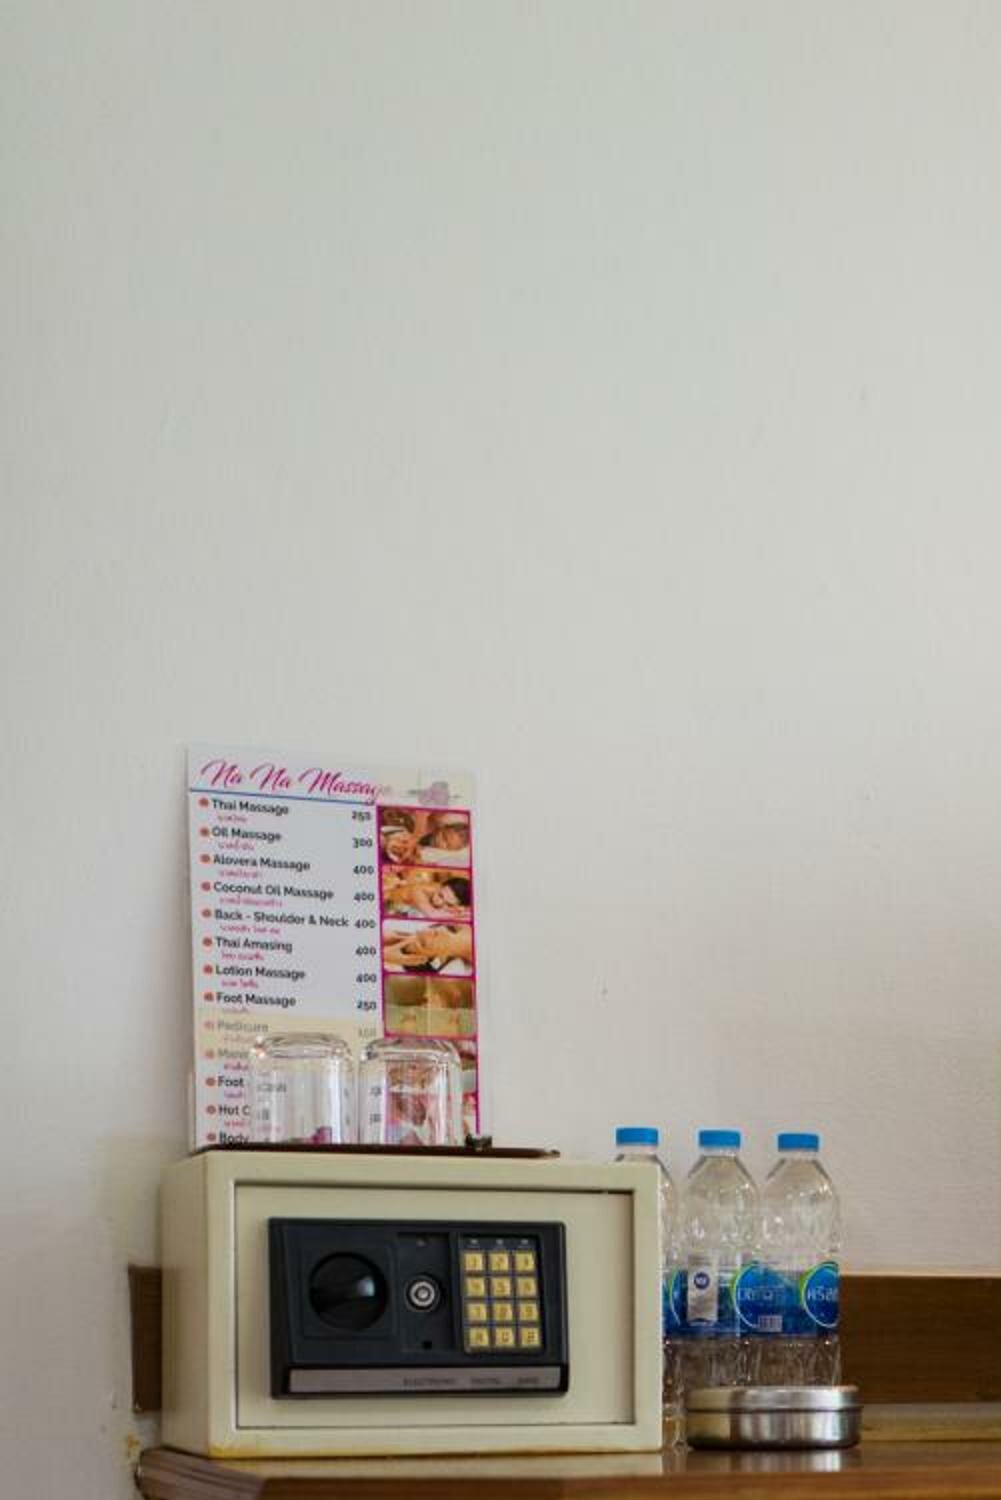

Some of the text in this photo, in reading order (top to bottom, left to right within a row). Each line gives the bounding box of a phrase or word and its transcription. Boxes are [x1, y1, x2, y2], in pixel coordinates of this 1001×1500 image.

[200, 759, 384, 806] Na Na Massag
[212, 799, 289, 816] Thai Massage
[211, 826, 282, 844] Oil Massage
[352, 837, 373, 849] 300
[213, 853, 257, 867] Alovera
[260, 857, 310, 873] Massage
[353, 865, 375, 875] 400
[213, 881, 262, 894] Coconut
[265, 884, 281, 897] Oil
[283, 886, 334, 902] Massage
[353, 892, 375, 903] 400
[214, 909, 242, 920] Back
[253, 911, 305, 925] Shoulder
[308, 914, 317, 926] &
[319, 915, 350, 928] Neck
[354, 919, 376, 930] 400
[216, 936, 240, 949] Thai
[355, 946, 377, 956] 400
[215, 964, 306, 981] Lotion Massage
[355, 973, 377, 984] 400
[216, 991, 297, 1009] Foot Massage
[217, 1075, 244, 1088] Foot
[217, 1104, 241, 1116] Hot
[219, 1131, 249, 1144] Body
